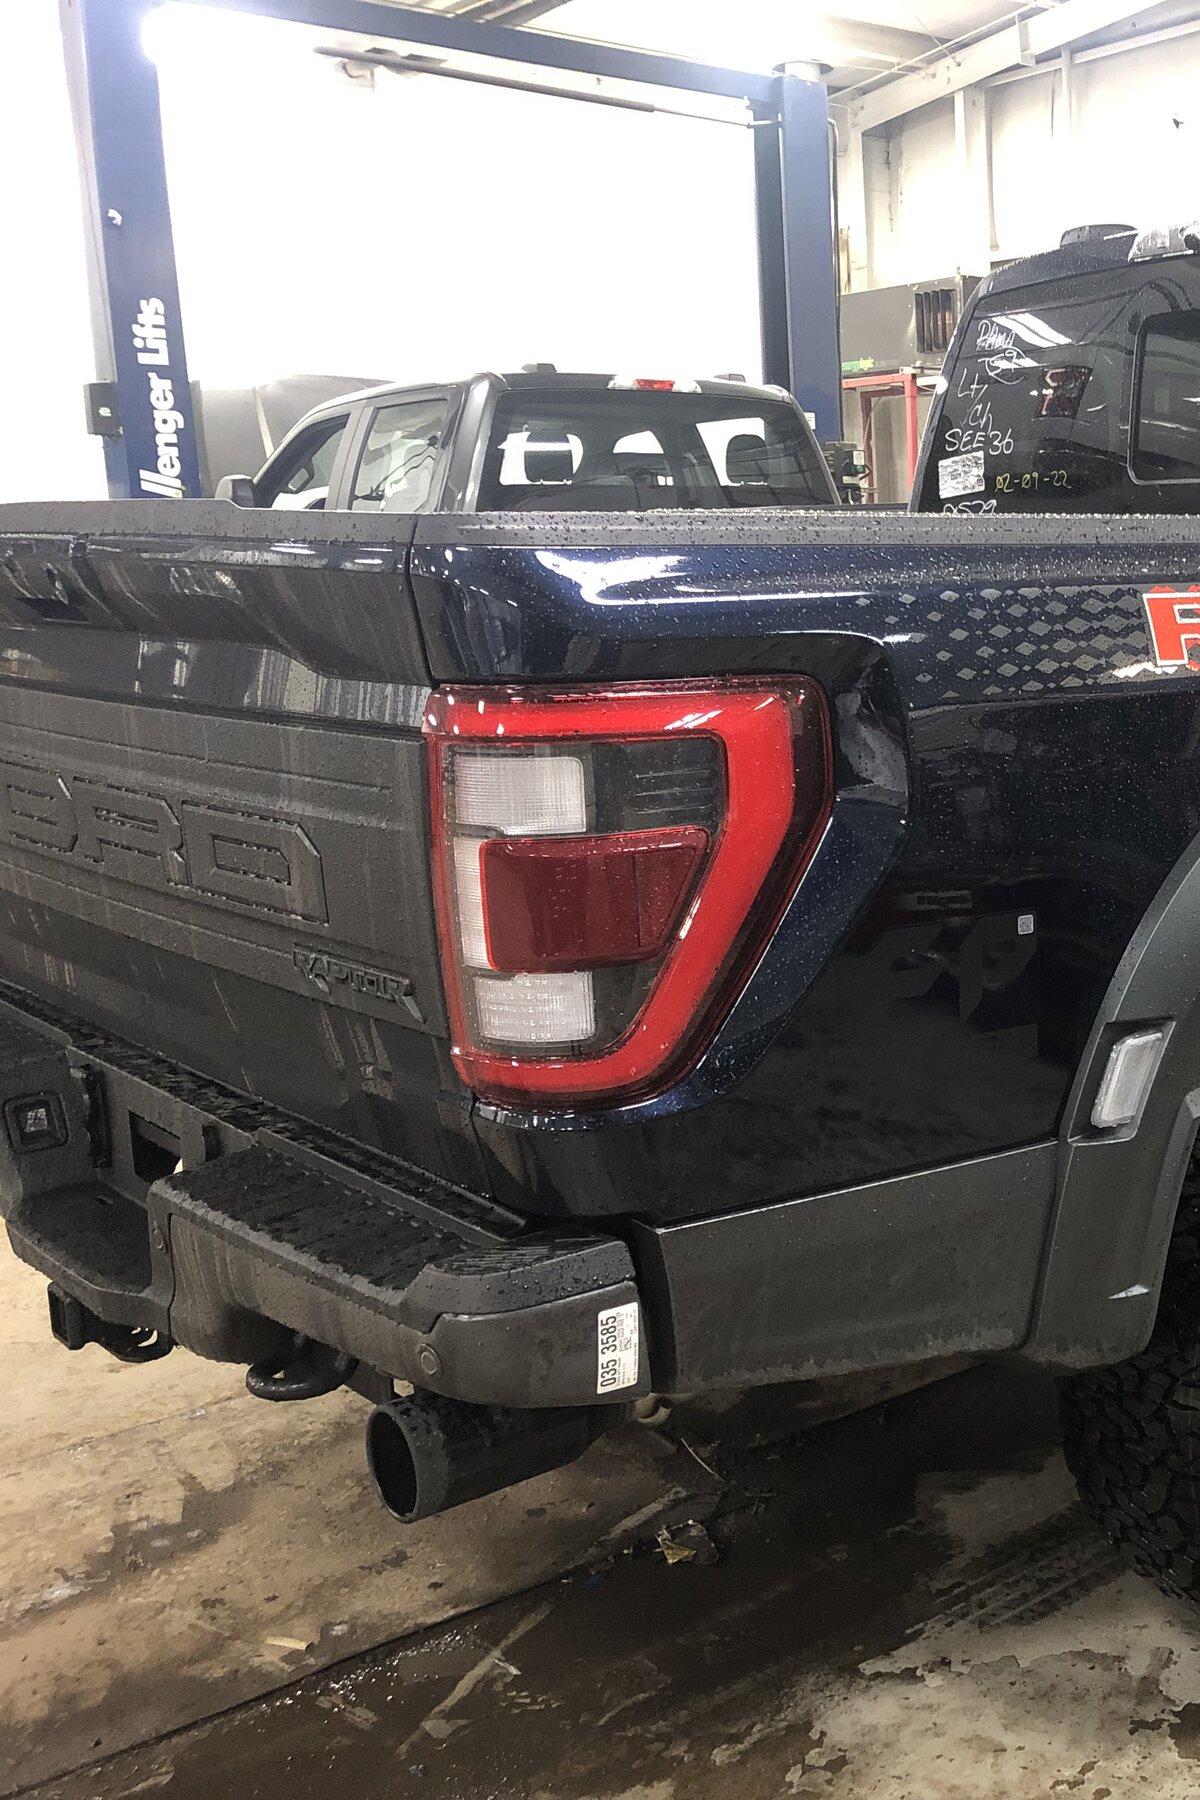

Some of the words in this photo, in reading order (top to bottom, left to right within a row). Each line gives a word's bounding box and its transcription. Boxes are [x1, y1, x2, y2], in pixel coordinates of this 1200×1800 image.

[131, 297, 170, 366] Lifts
[945, 428, 986, 452] SEE
[293, 944, 427, 1025] RAPTOR
[600, 1315, 617, 1355] 3585
[600, 1359, 617, 1388] 035
